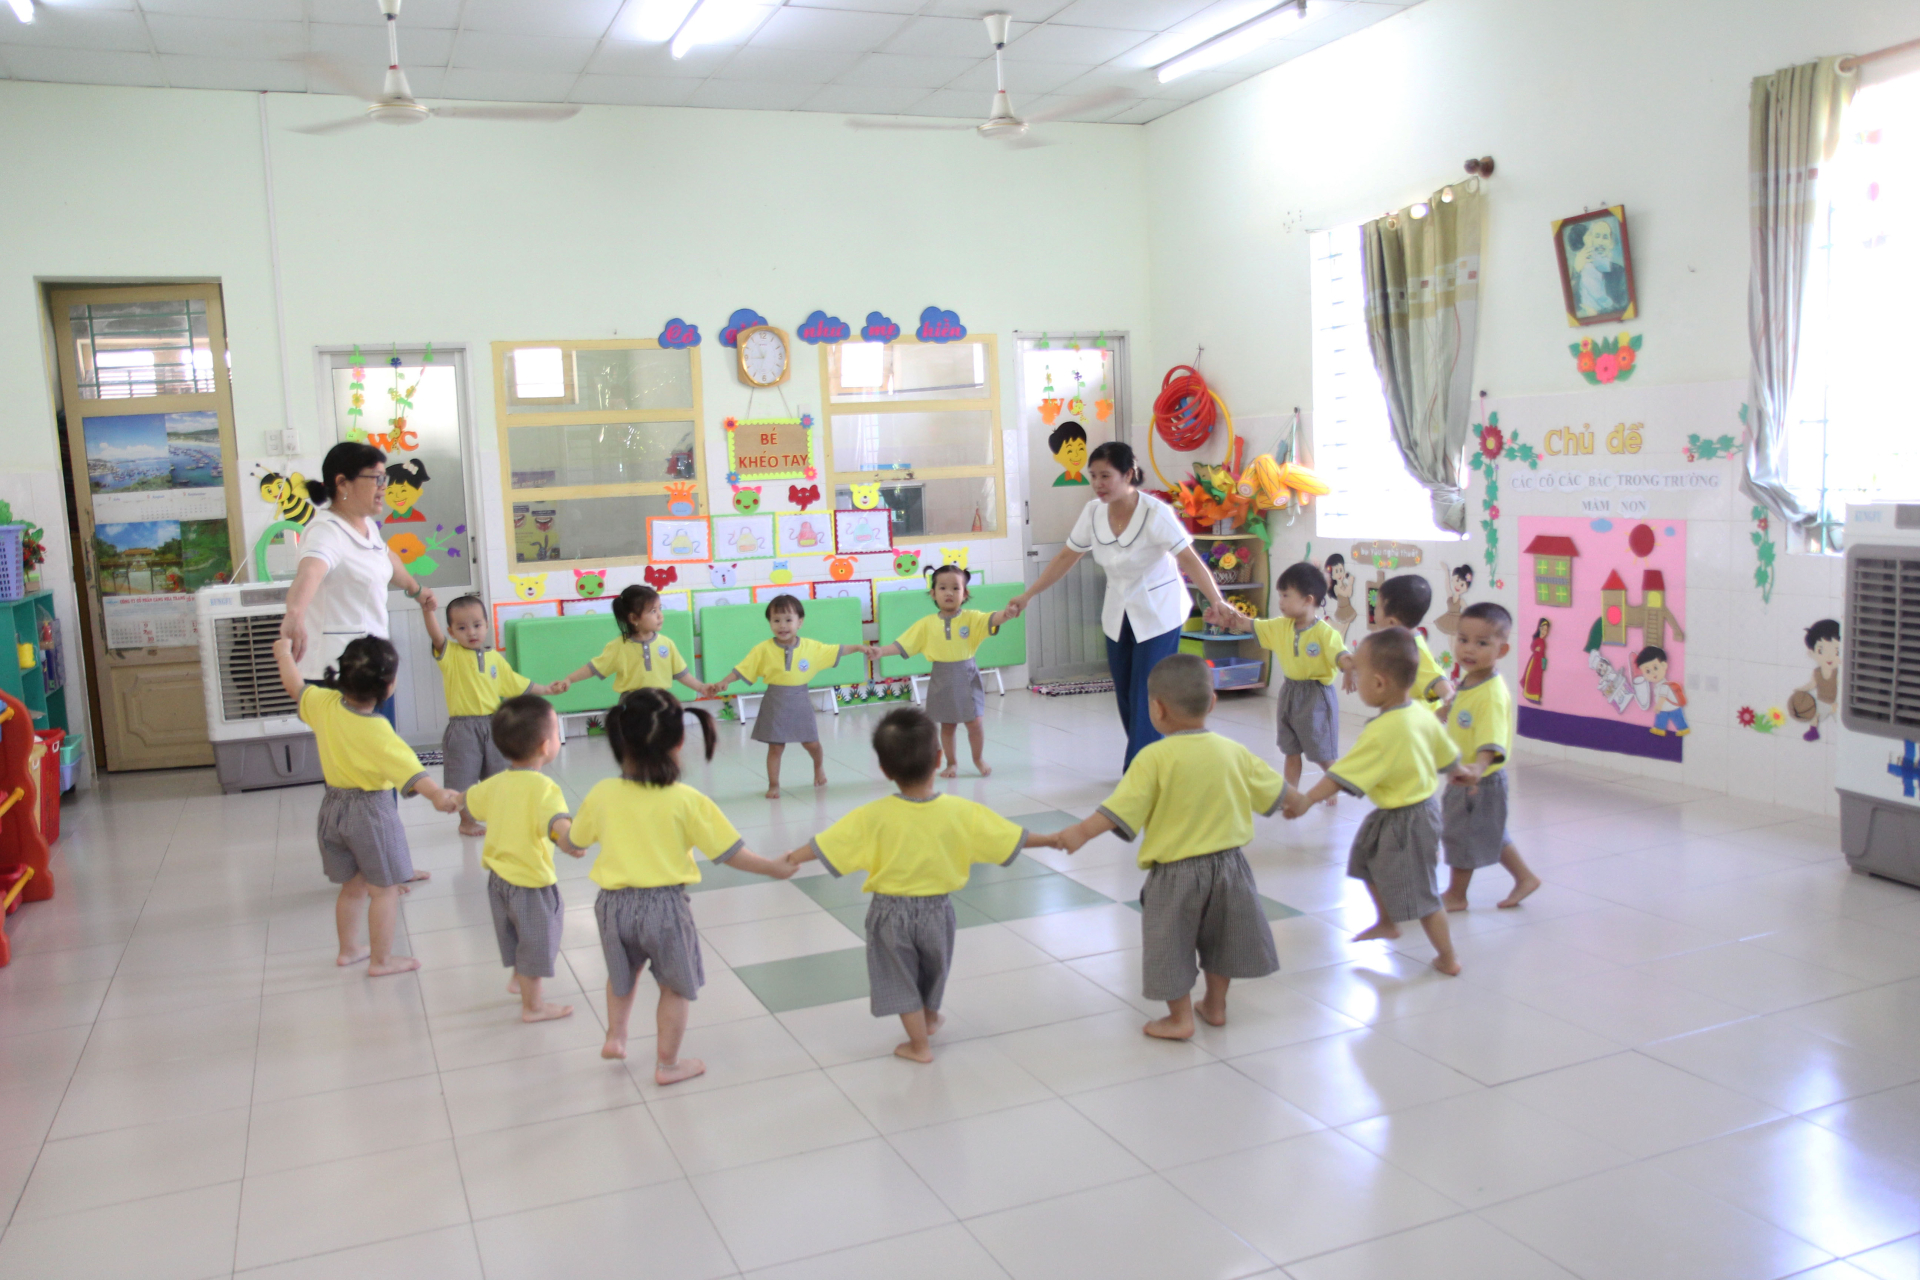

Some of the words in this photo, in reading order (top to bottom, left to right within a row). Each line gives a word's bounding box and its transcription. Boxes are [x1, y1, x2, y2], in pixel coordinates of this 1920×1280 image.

[803, 320, 846, 339] như
[868, 323, 898, 340] mẹ
[922, 318, 963, 339] hiền
[760, 427, 778, 446] BÉ
[1543, 423, 1595, 456] Chủ
[1605, 422, 1645, 455] đề
[738, 450, 779, 468] KHÉO
[781, 454, 808, 467] TAY
[1617, 474, 1660, 487] TRONG
[1621, 500, 1647, 512] NON
